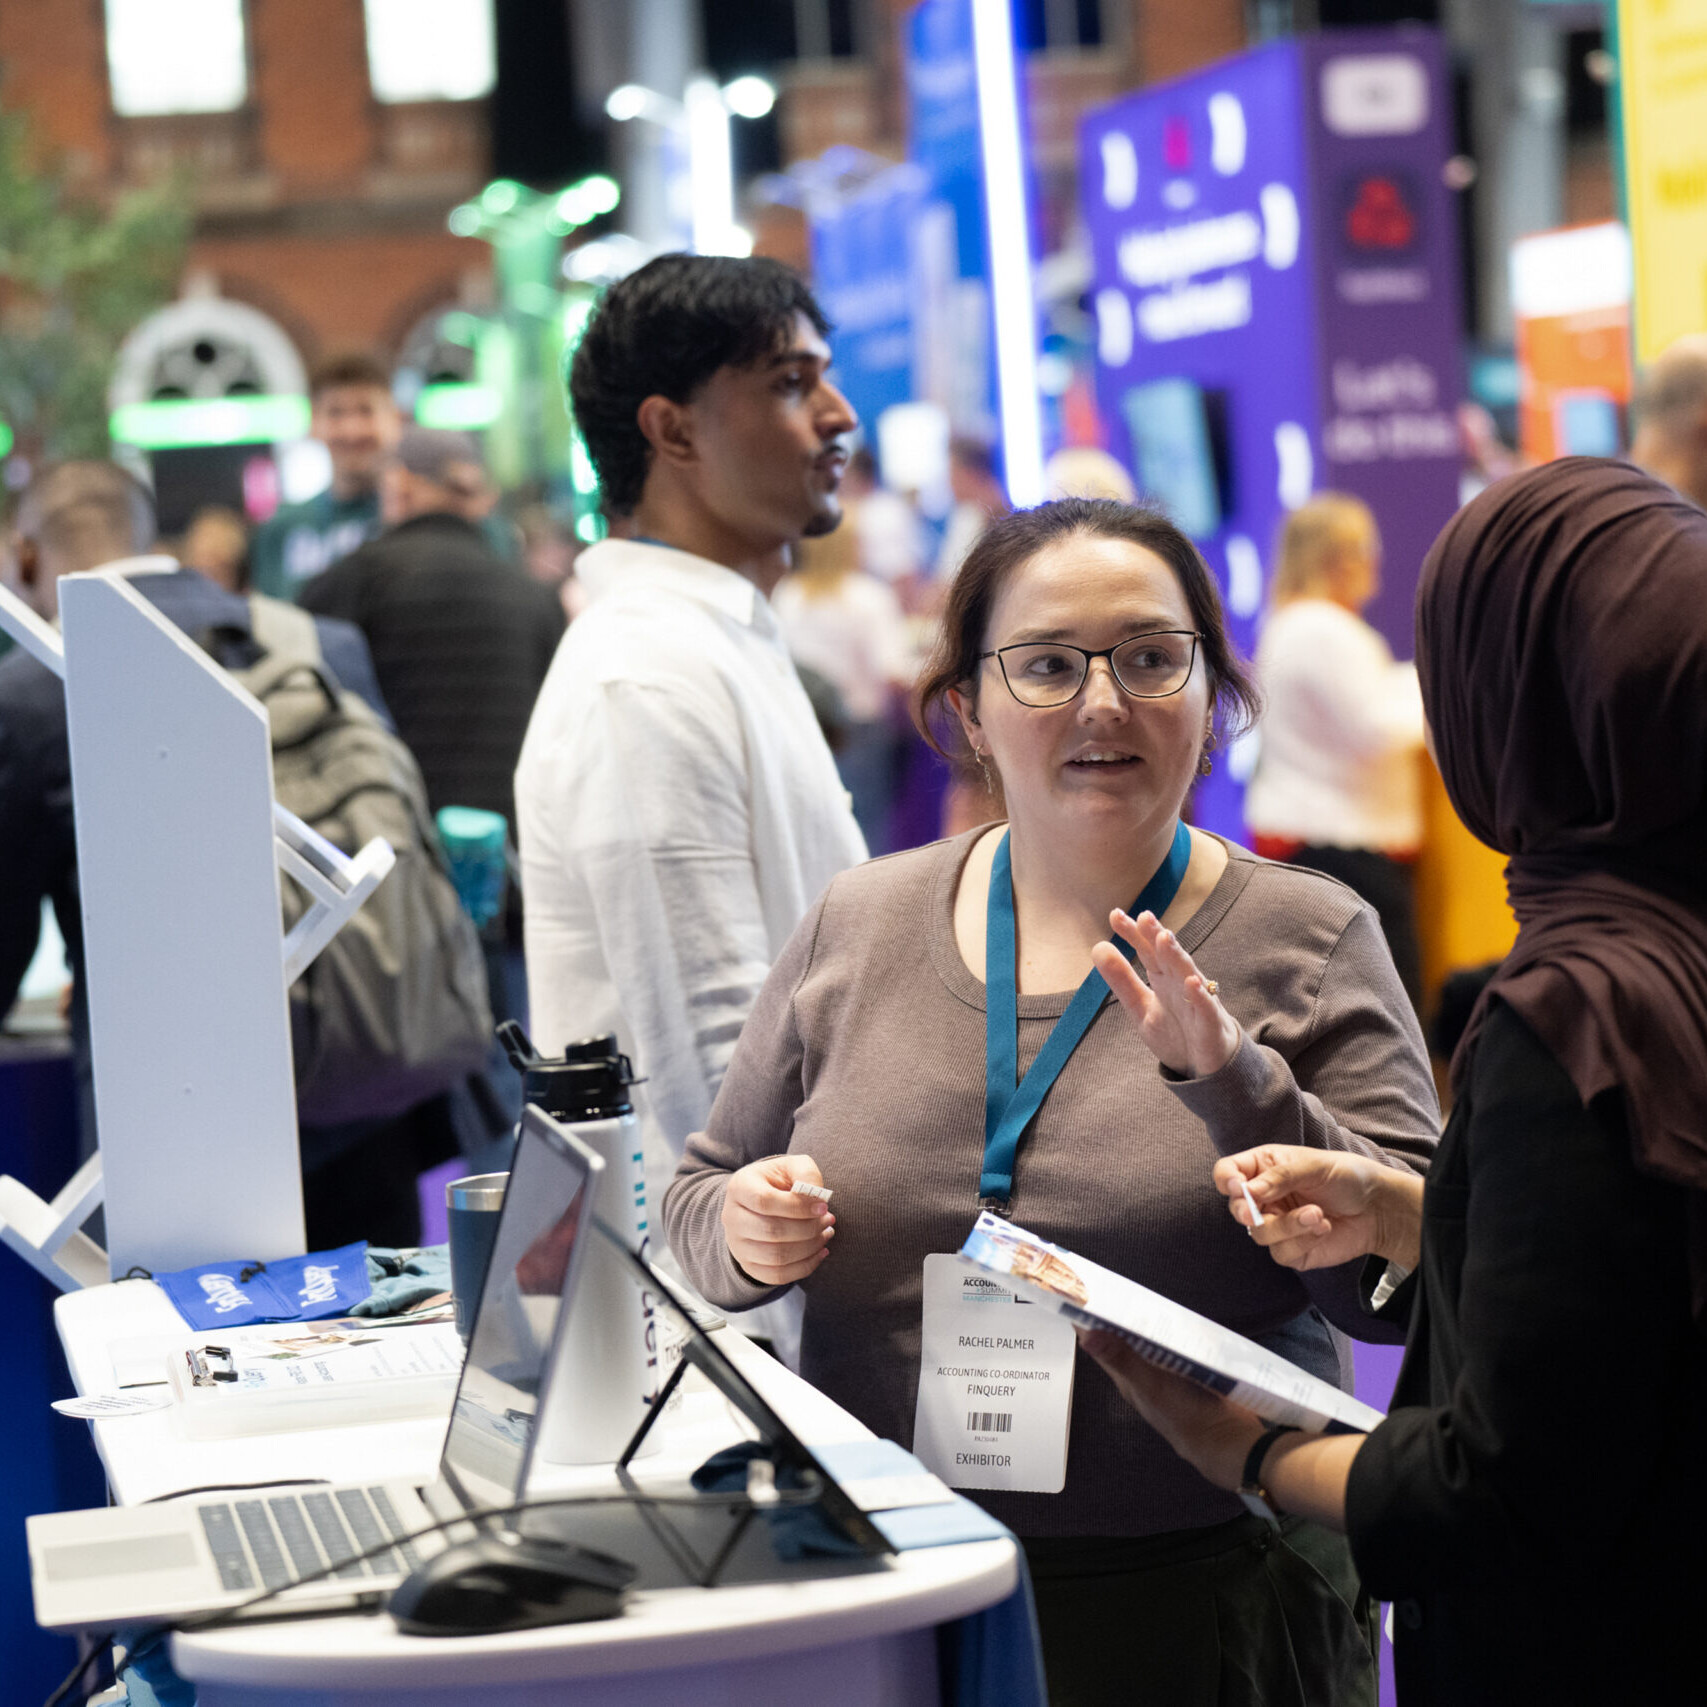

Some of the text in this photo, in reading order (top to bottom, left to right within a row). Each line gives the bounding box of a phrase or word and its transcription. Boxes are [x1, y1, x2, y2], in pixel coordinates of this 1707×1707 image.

[962, 1295, 1012, 1303] MANCHESTER
[958, 1335, 1035, 1350] RACHEL PALMER
[937, 1367, 1050, 1381] ACCOUNTING CO-ORDINATOR
[967, 1383, 1016, 1397] FINQUERY
[956, 1453, 1012, 1467] EXHIBITOR
